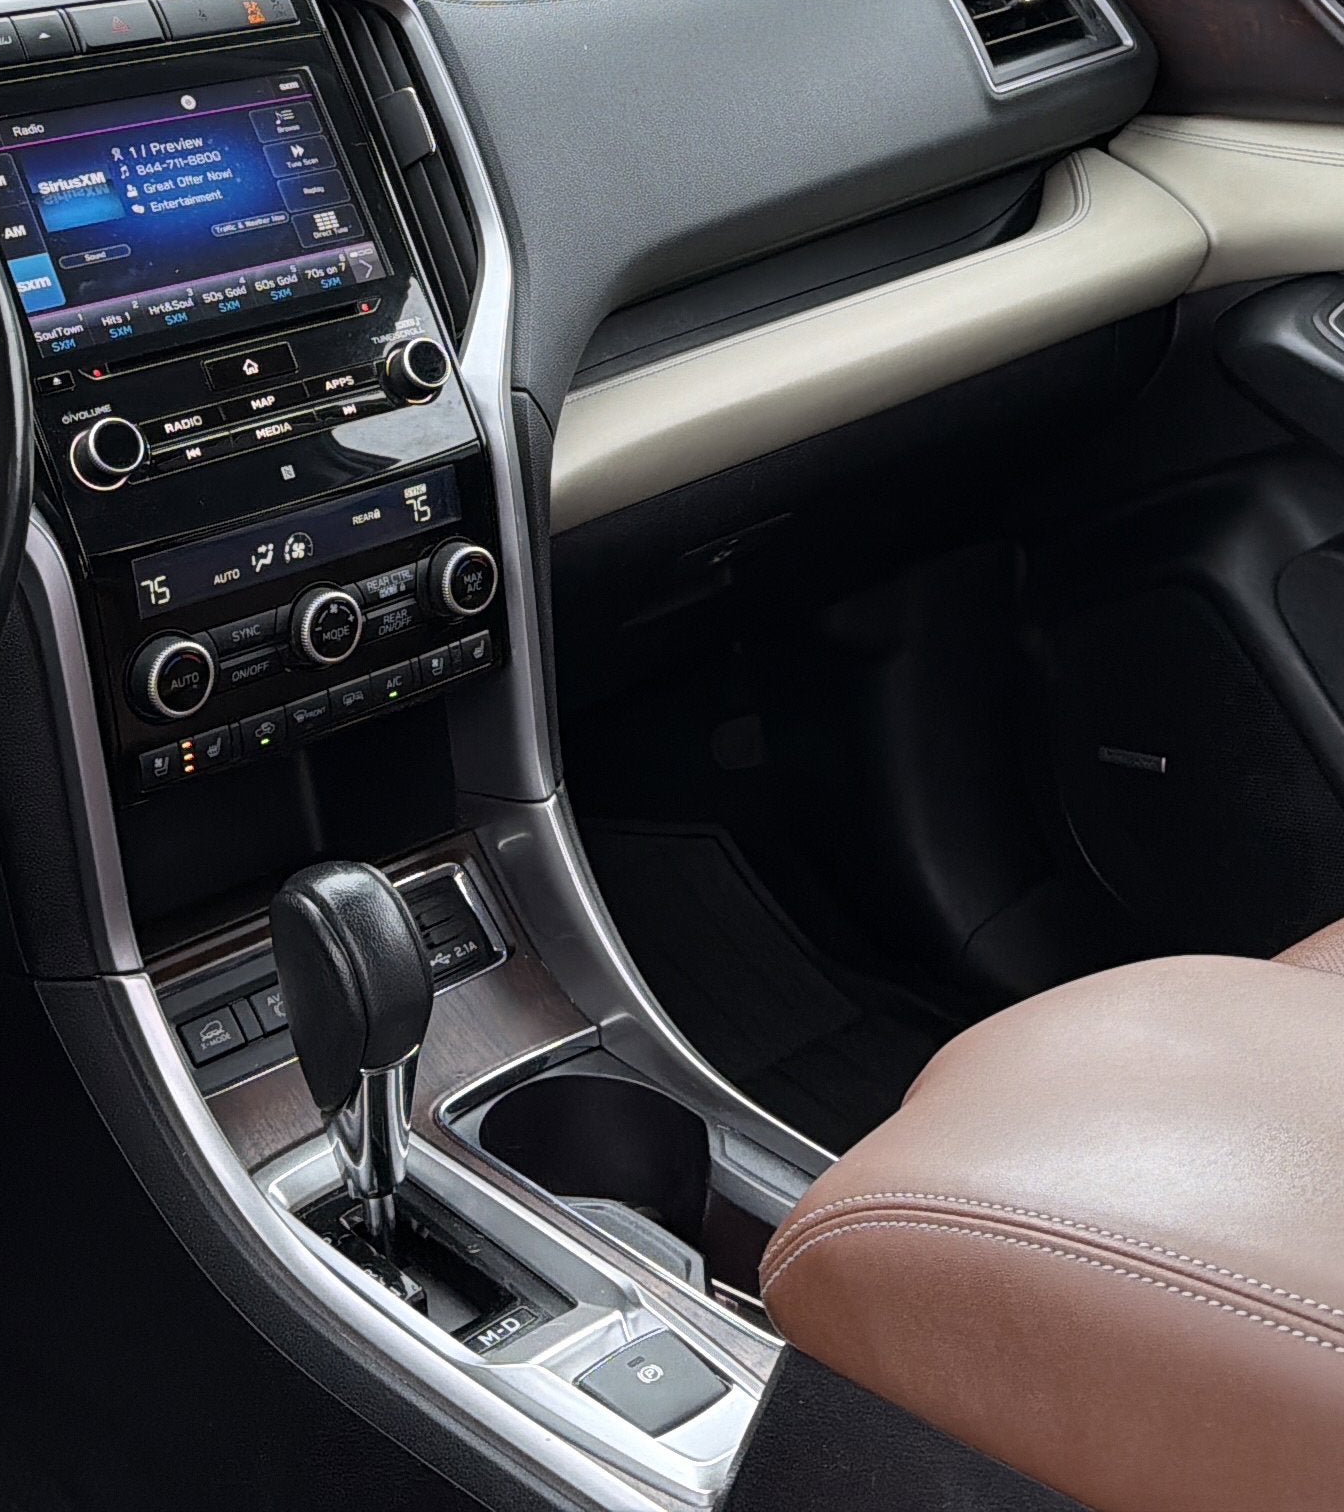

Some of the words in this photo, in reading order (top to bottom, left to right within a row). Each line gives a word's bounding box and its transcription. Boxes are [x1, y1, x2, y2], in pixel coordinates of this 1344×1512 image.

[12, 123, 45, 137] Radio
[150, 137, 203, 155] Preview
[136, 150, 222, 176] 844-711-8800
[37, 171, 106, 195] SiriusXM
[143, 180, 175, 195] Great
[176, 175, 204, 189] Offer
[150, 189, 224, 213] Entertainment
[5, 224, 27, 239] AM
[276, 274, 298, 287] Gold
[320, 276, 343, 289] SXM
[186, 287, 194, 297] 3
[225, 285, 247, 299] Gold
[270, 288, 292, 301] SXM
[131, 300, 139, 309] 2
[218, 300, 241, 313] SXM
[164, 312, 188, 326] SXM
[34, 324, 84, 343] SoulTown
[109, 325, 133, 339] SXM
[51, 340, 76, 353] SXM
[325, 375, 355, 391] APPS
[251, 395, 276, 411] MAP
[164, 415, 203, 434] RADIO
[255, 421, 293, 439] MEDIA
[406, 495, 431, 522] 75
[352, 512, 375, 525] REAR
[214, 568, 240, 585] AUTO
[367, 576, 389, 592] REAR
[463, 571, 483, 585] MAX
[141, 576, 170, 605] 75
[466, 583, 482, 593] A/C
[383, 609, 407, 625] REAR
[232, 625, 261, 642] SYNC
[323, 625, 350, 642] MODE
[232, 661, 270, 682] ON/OFF
[171, 672, 199, 689] AUTO
[387, 676, 403, 689] A/C
[453, 940, 477, 957] 2.1A
[267, 993, 281, 1006] AV
[200, 1032, 232, 1050] X-MODE
